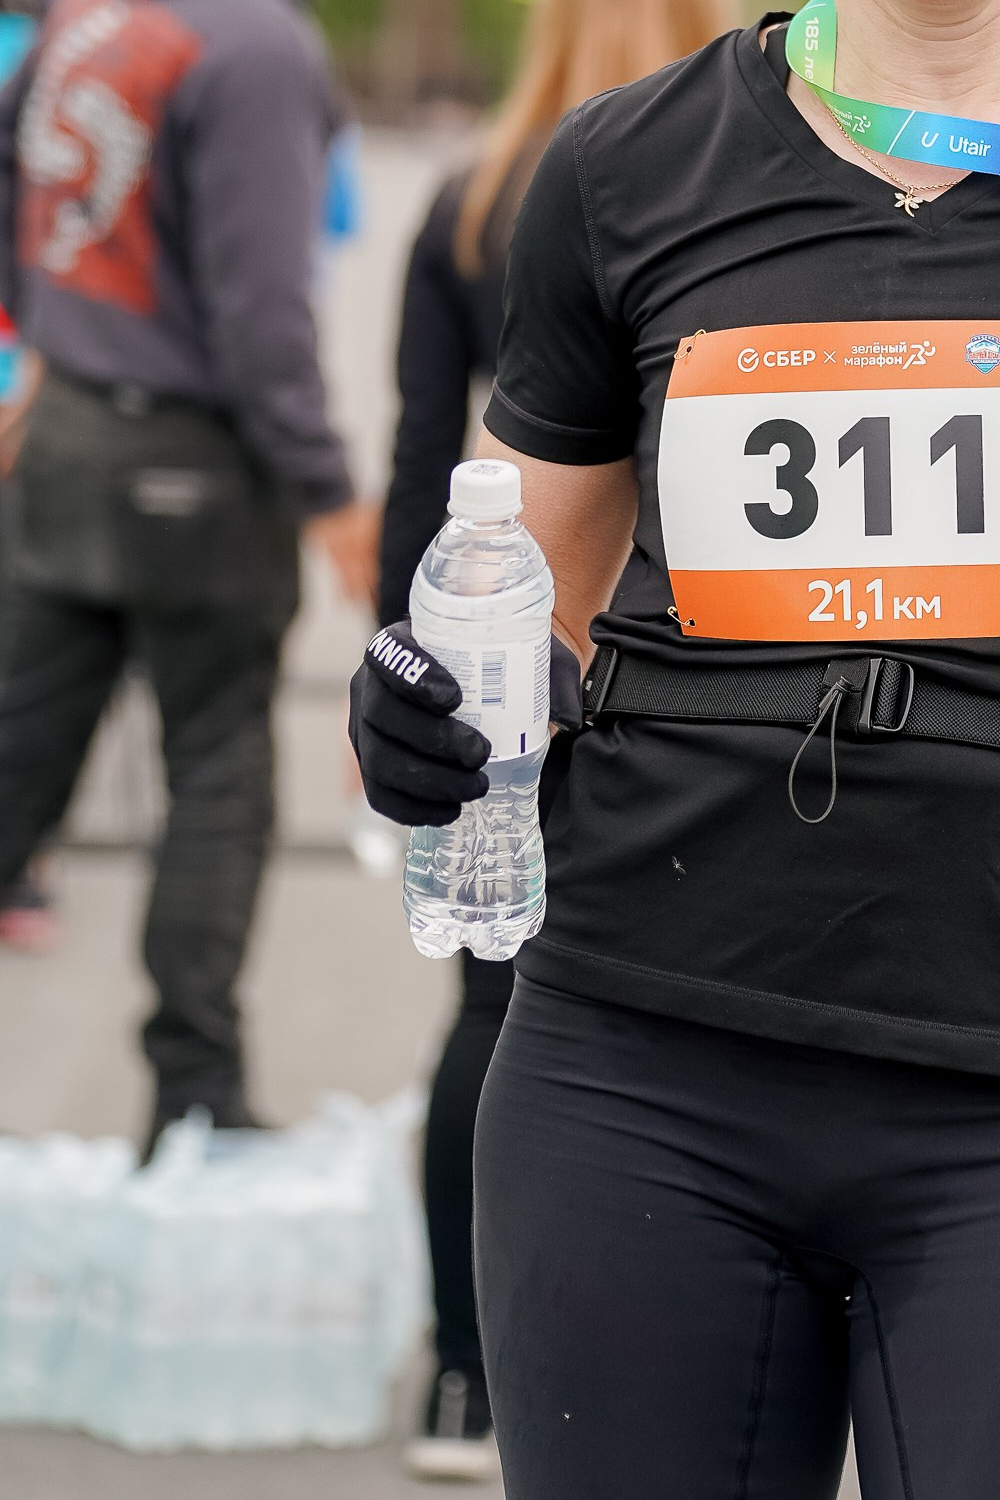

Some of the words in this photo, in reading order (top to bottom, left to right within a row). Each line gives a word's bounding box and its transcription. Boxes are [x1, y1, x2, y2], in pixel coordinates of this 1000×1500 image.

[804, 17, 820, 52] 185
[804, 56, 815, 82] ле
[948, 135, 991, 157] Utair
[763, 349, 816, 367] СБЕР
[850, 341, 908, 355] зелёный
[843, 355, 903, 368] марафон
[743, 415, 986, 540] 311
[807, 578, 885, 630] 21,1
[893, 595, 942, 620] км
